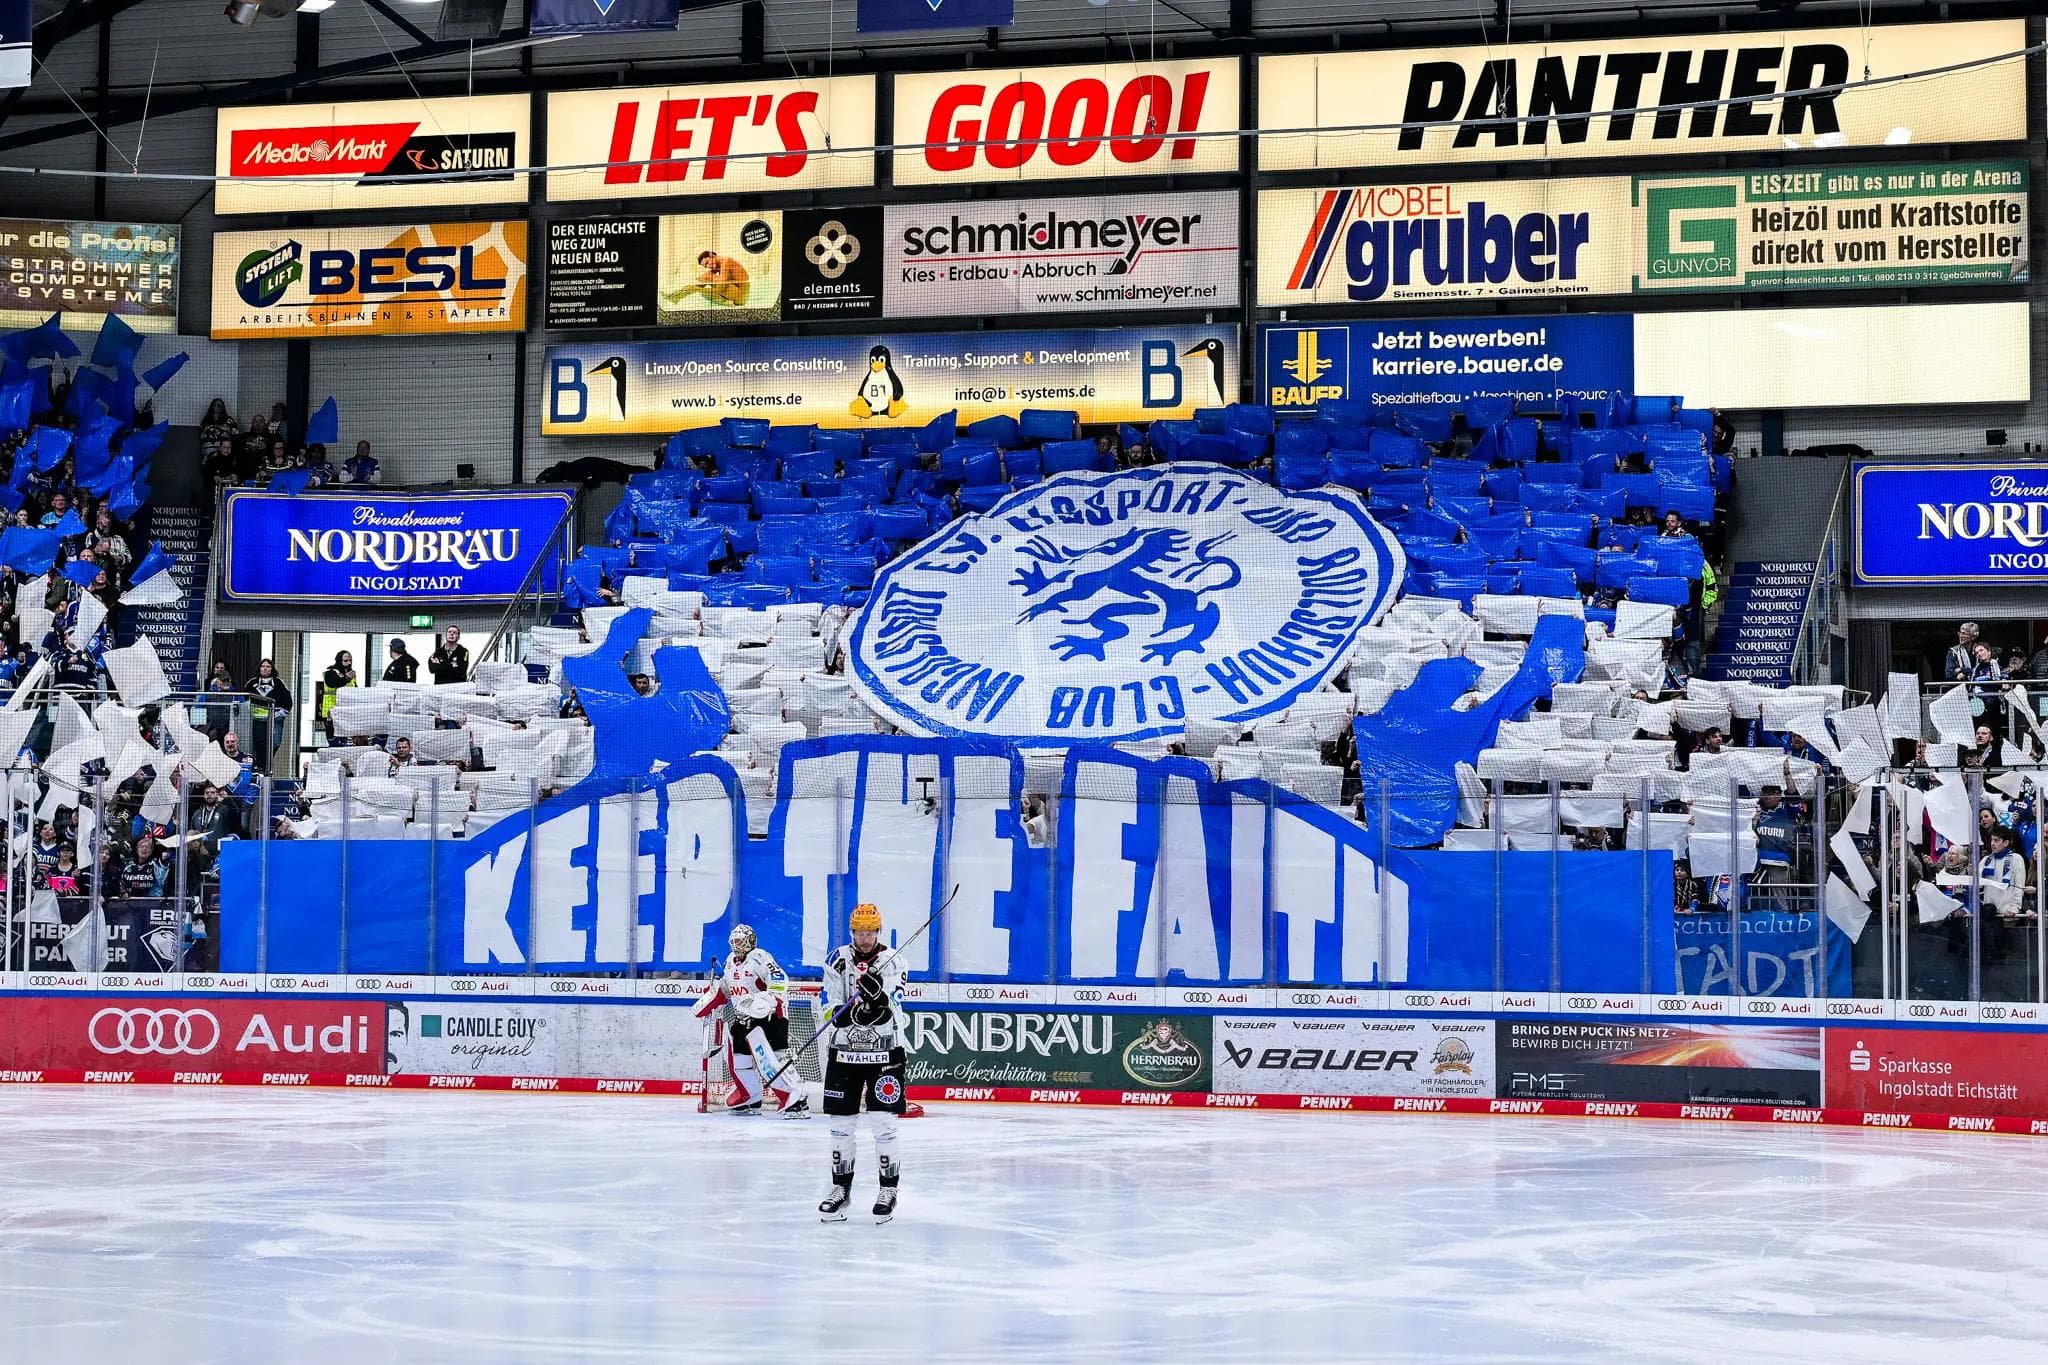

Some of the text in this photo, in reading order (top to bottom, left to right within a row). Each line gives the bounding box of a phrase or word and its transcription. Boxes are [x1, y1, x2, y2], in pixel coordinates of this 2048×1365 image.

[1397, 44, 1849, 151] PANTHER
[924, 71, 1210, 172] GOOO!
[603, 91, 819, 184] LET'S
[440, 146, 509, 171] SATURN
[1751, 169, 2021, 195] EISZEIT gibt es nur in der Arena
[1352, 185, 1460, 218] MÖBEL
[1751, 200, 2022, 233] Heizöl und Kraftstoffe
[552, 221, 646, 237] DER EINFACHSTE
[903, 211, 1201, 262] schmidmeyer
[28, 231, 70, 249] die
[81, 232, 176, 253] Profis!
[551, 237, 606, 251] WEG ZUM
[1345, 201, 1589, 301] gruber
[1751, 233, 2022, 265] direkt vom Hersteller
[11, 257, 172, 276] STRÖHMER
[243, 246, 293, 286] SYSTEM
[551, 251, 619, 266] NEUEN BAD
[1653, 257, 1732, 274] GUNVOR
[267, 265, 294, 290] LIFT
[309, 245, 507, 295] BESL
[902, 260, 1097, 283] Kies Erdbau Abbruch
[1751, 274, 1850, 287] gunvor-deutschland.de
[1857, 273, 1873, 283] Tel.
[1875, 273, 1896, 281] 0800
[1897, 273, 1913, 281] 213
[1922, 272, 1938, 280] 312
[1940, 269, 2003, 281] (gebührenfrei)
[10, 272, 172, 290] COMPUTER
[803, 282, 861, 295] elements
[18, 286, 164, 303] SYSTEME
[1037, 284, 1217, 304] www.schmidmeyer.net
[1393, 288, 1472, 299] Siemensstr.
[1477, 288, 1484, 296] 7
[239, 306, 507, 325] ARBEITSBÜHNEN & STAPLER
[1371, 328, 1546, 350] Jetzt bewerben!
[645, 358, 847, 377] Linux/Open Source Consulting,
[903, 348, 1130, 369] Training, Support & Development
[1372, 354, 1564, 376] karriere.bauer.de
[1371, 391, 1461, 406] Spezialtiefbau
[352, 505, 464, 528] Privatbrauerei
[1917, 502, 2048, 547] NORD
[286, 528, 520, 571] NORDBRÄU
[1760, 562, 1815, 573] NORDBRÄU
[349, 575, 464, 592] INGOLSTADT
[1750, 588, 1806, 599] NORDBRÄU
[137, 611, 188, 622] NORDBRÄU
[1742, 615, 1798, 625] NORDBRÄU
[135, 624, 187, 634] NORDBRÄU
[1735, 641, 1792, 652] NORDBRÄU
[1726, 668, 1783, 679] NORDBRÄU
[463, 751, 1409, 983] KEEP THE FAITH
[57, 976, 87, 986] Audi
[219, 977, 248, 988] Audi
[580, 982, 609, 993] Audi
[1107, 991, 1137, 1001] Audi
[1326, 994, 1357, 1005] Audi
[1691, 1000, 1723, 1011] Audi
[1854, 1004, 1884, 1015] Audi
[2010, 1009, 2037, 1019] Audi
[236, 1014, 368, 1054] Audi
[447, 1018, 503, 1038] CANDLE
[902, 1012, 1113, 1057] RNBRÄU
[1512, 1024, 1669, 1039] BRING DEN PUCK INS NETZ
[450, 1036, 536, 1070] original
[1512, 1038, 1634, 1051] BEWIRB DICH JETZT!
[846, 1052, 888, 1063] WÄHLER
[1131, 1054, 1197, 1066] HERRNBRÄU
[1430, 1050, 1474, 1064] Fairplay
[1879, 1056, 1952, 1075] Sparkasse
[905, 1059, 1047, 1083] ißbier-Spezialitäten
[1513, 1072, 1564, 1090] FMS
[1879, 1079, 2018, 1100] Ingolstadt Eichstätt
[832, 1150, 841, 1165] 9
[880, 1154, 889, 1169] 9
